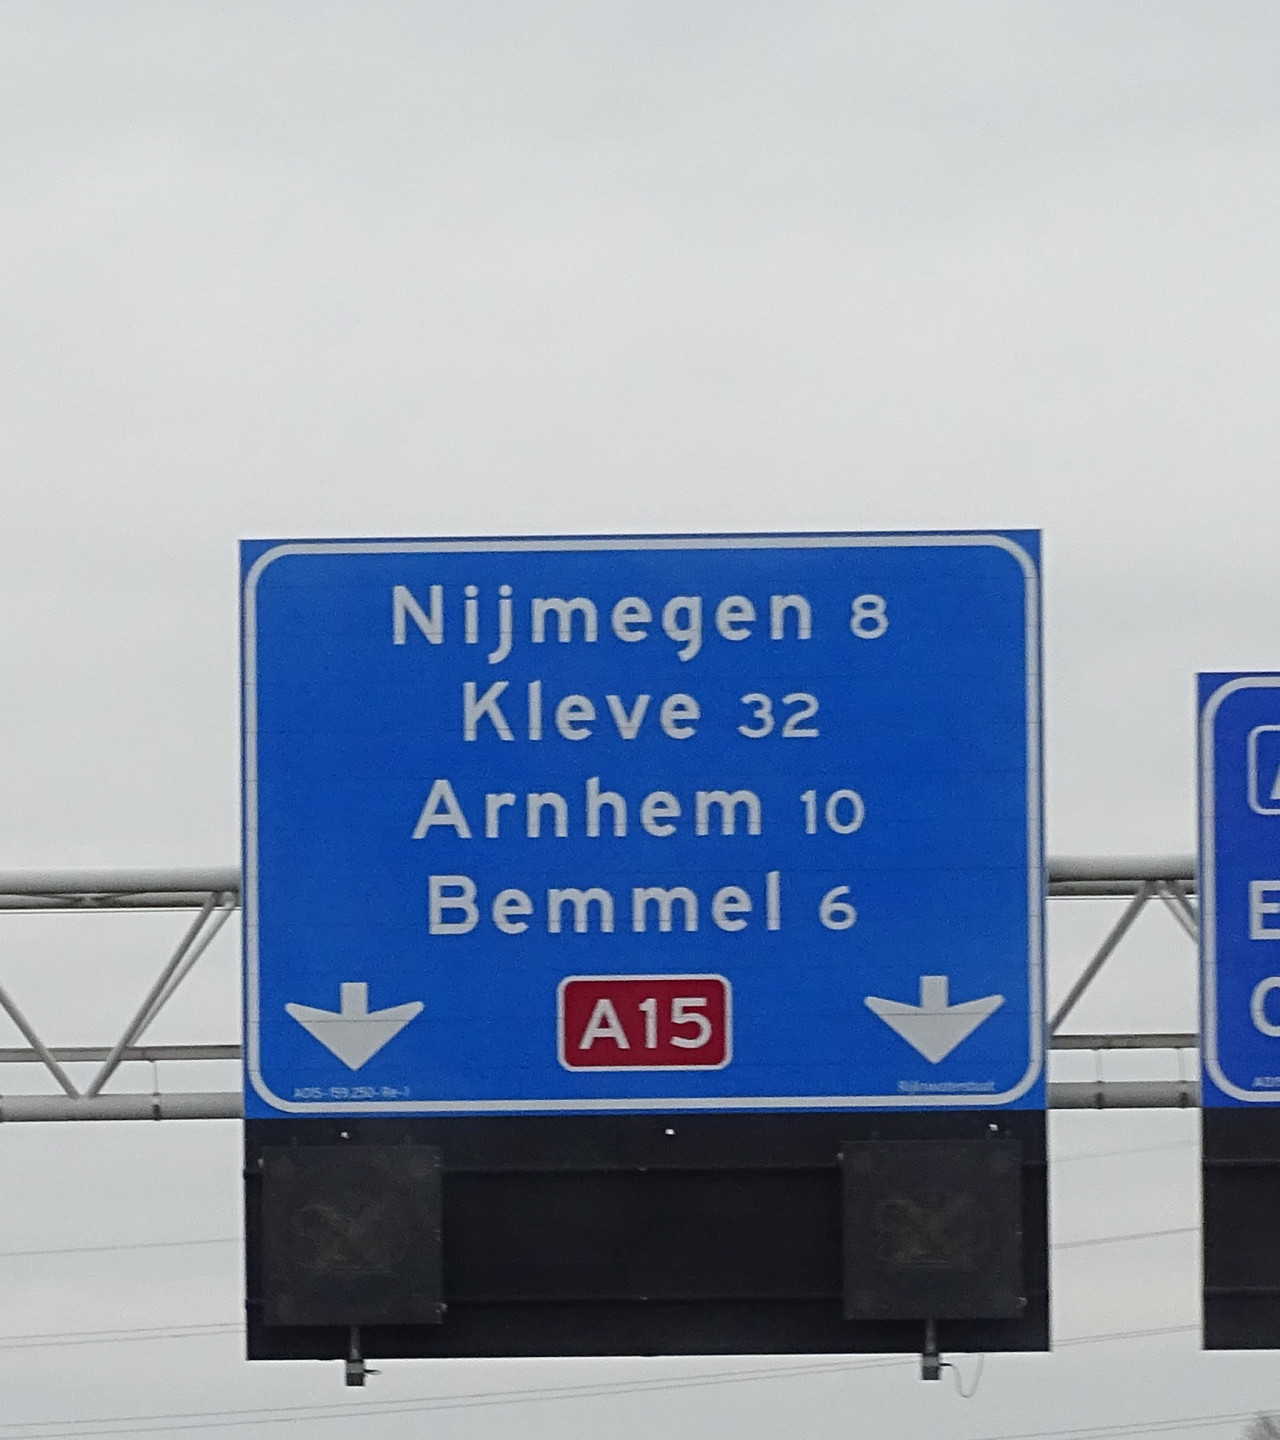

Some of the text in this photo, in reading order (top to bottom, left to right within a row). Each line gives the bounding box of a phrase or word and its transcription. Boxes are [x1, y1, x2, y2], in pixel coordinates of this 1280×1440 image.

[392, 584, 890, 665] Nijmegen 8
[463, 679, 820, 742] Kleve 32
[411, 776, 865, 840] Arnhem 10
[428, 870, 857, 935] Bemmel 6
[579, 997, 713, 1050] A15
